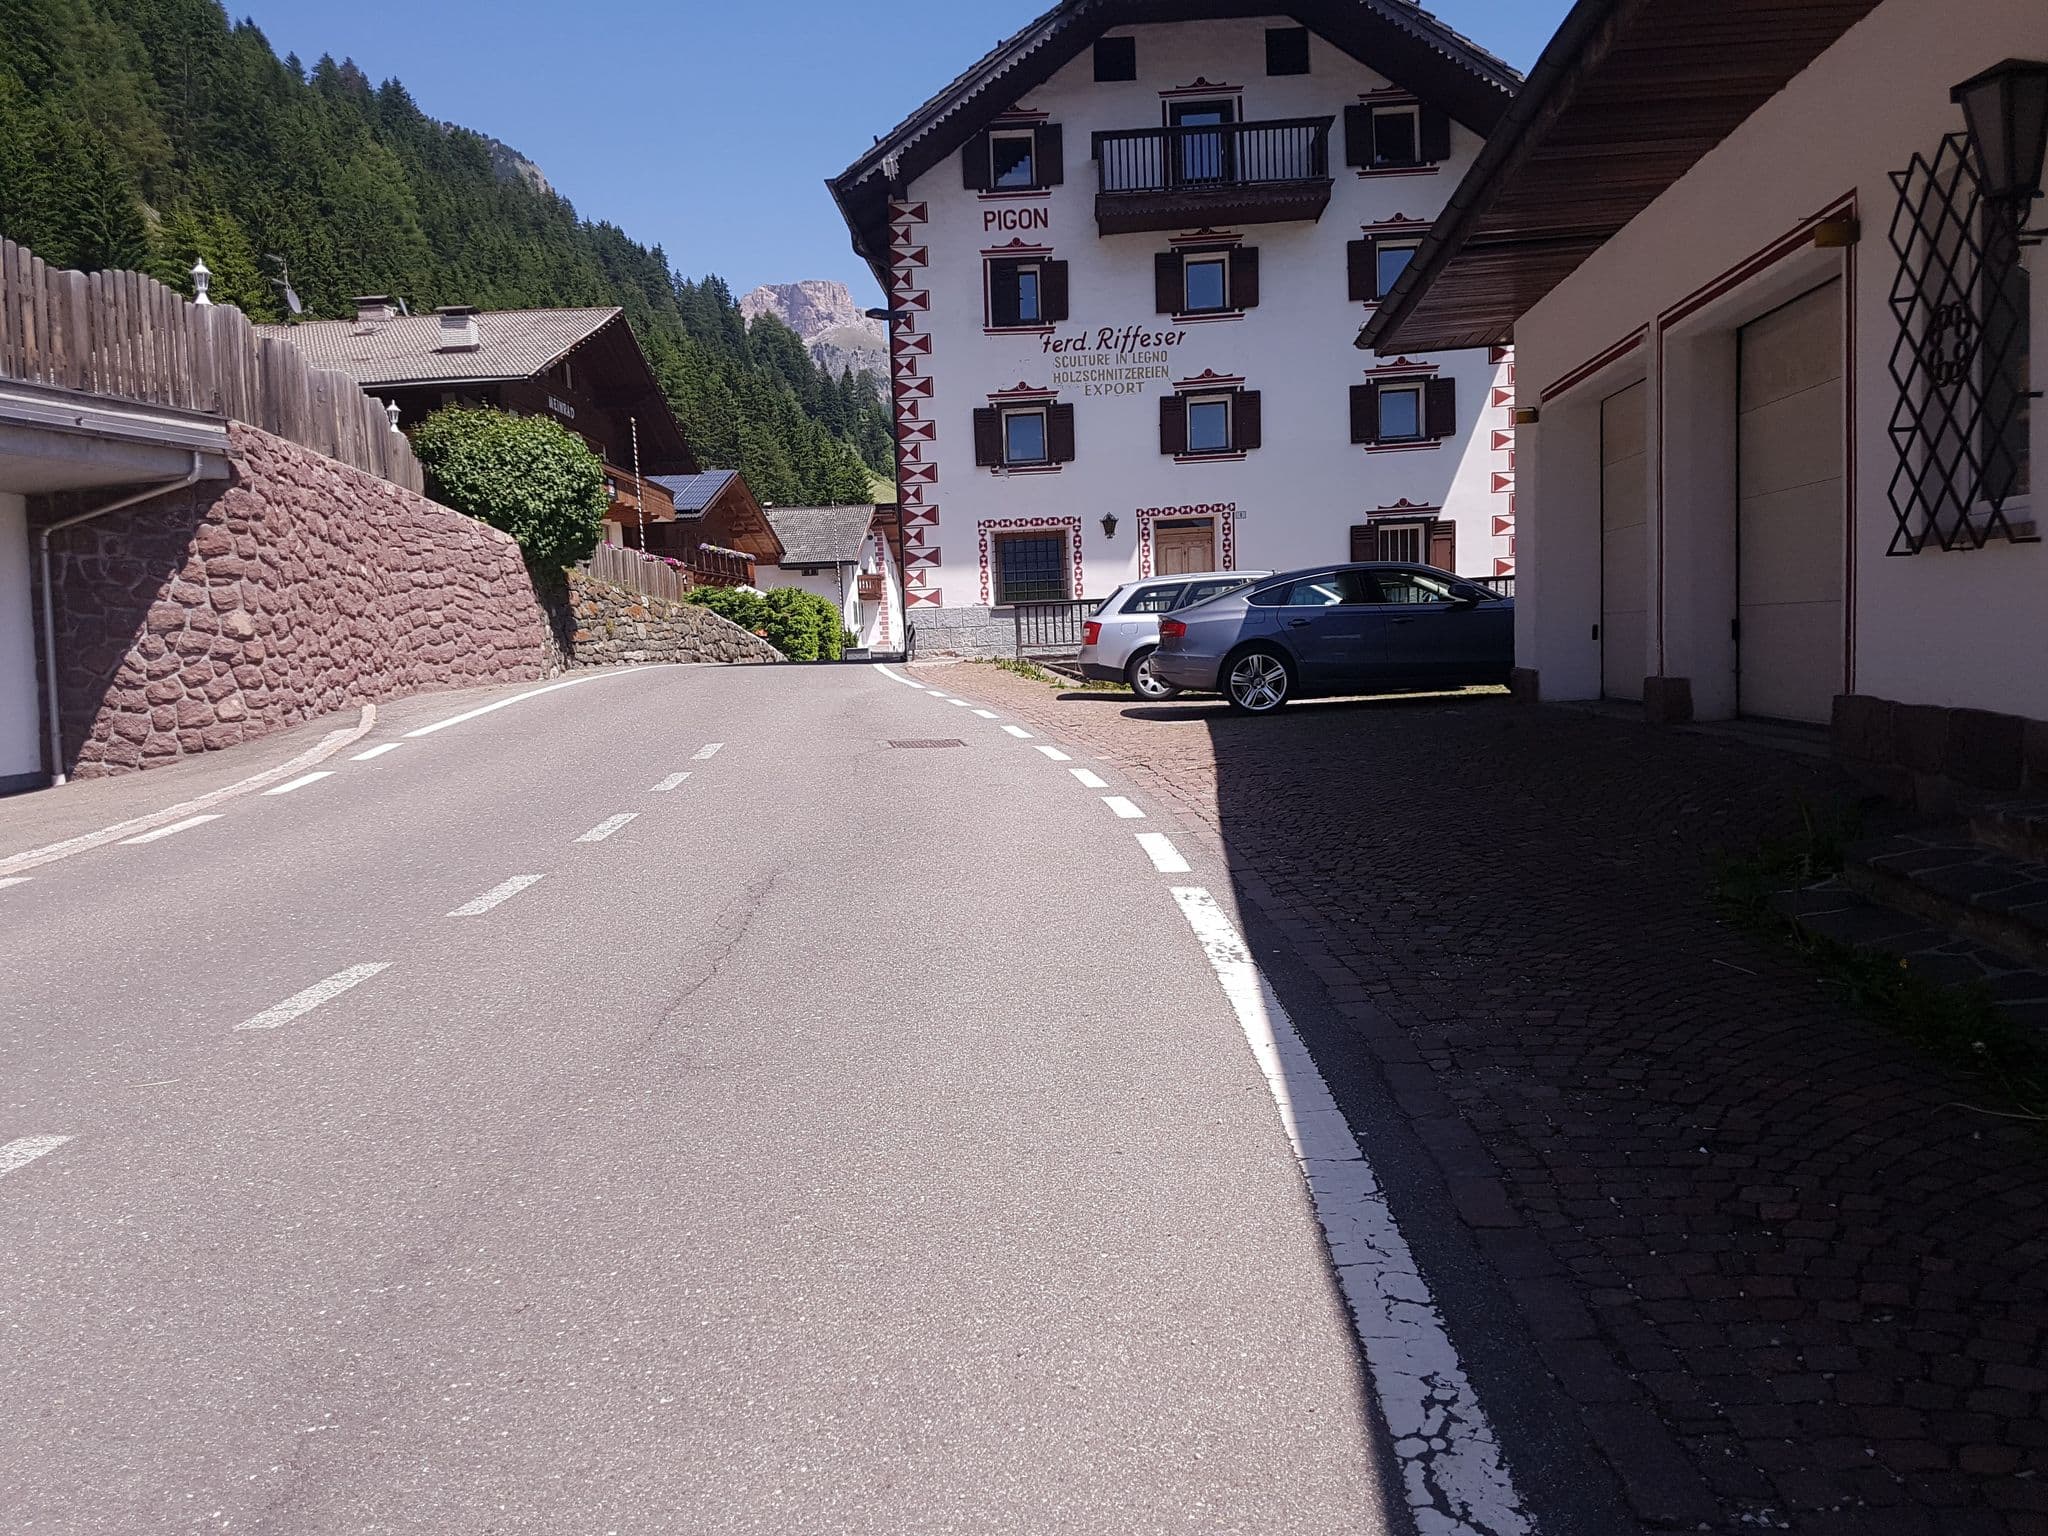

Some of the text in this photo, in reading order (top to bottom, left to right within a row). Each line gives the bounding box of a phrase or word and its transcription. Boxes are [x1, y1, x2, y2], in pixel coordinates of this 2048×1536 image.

[983, 207, 1049, 232] PIGON
[1096, 325, 1187, 354] Riffeser
[1054, 350, 1168, 369] SCULTURE IN LEGNO
[1053, 365, 1169, 384] HOLZSCHNITZEREIEN
[1084, 381, 1145, 397] EXPORT
